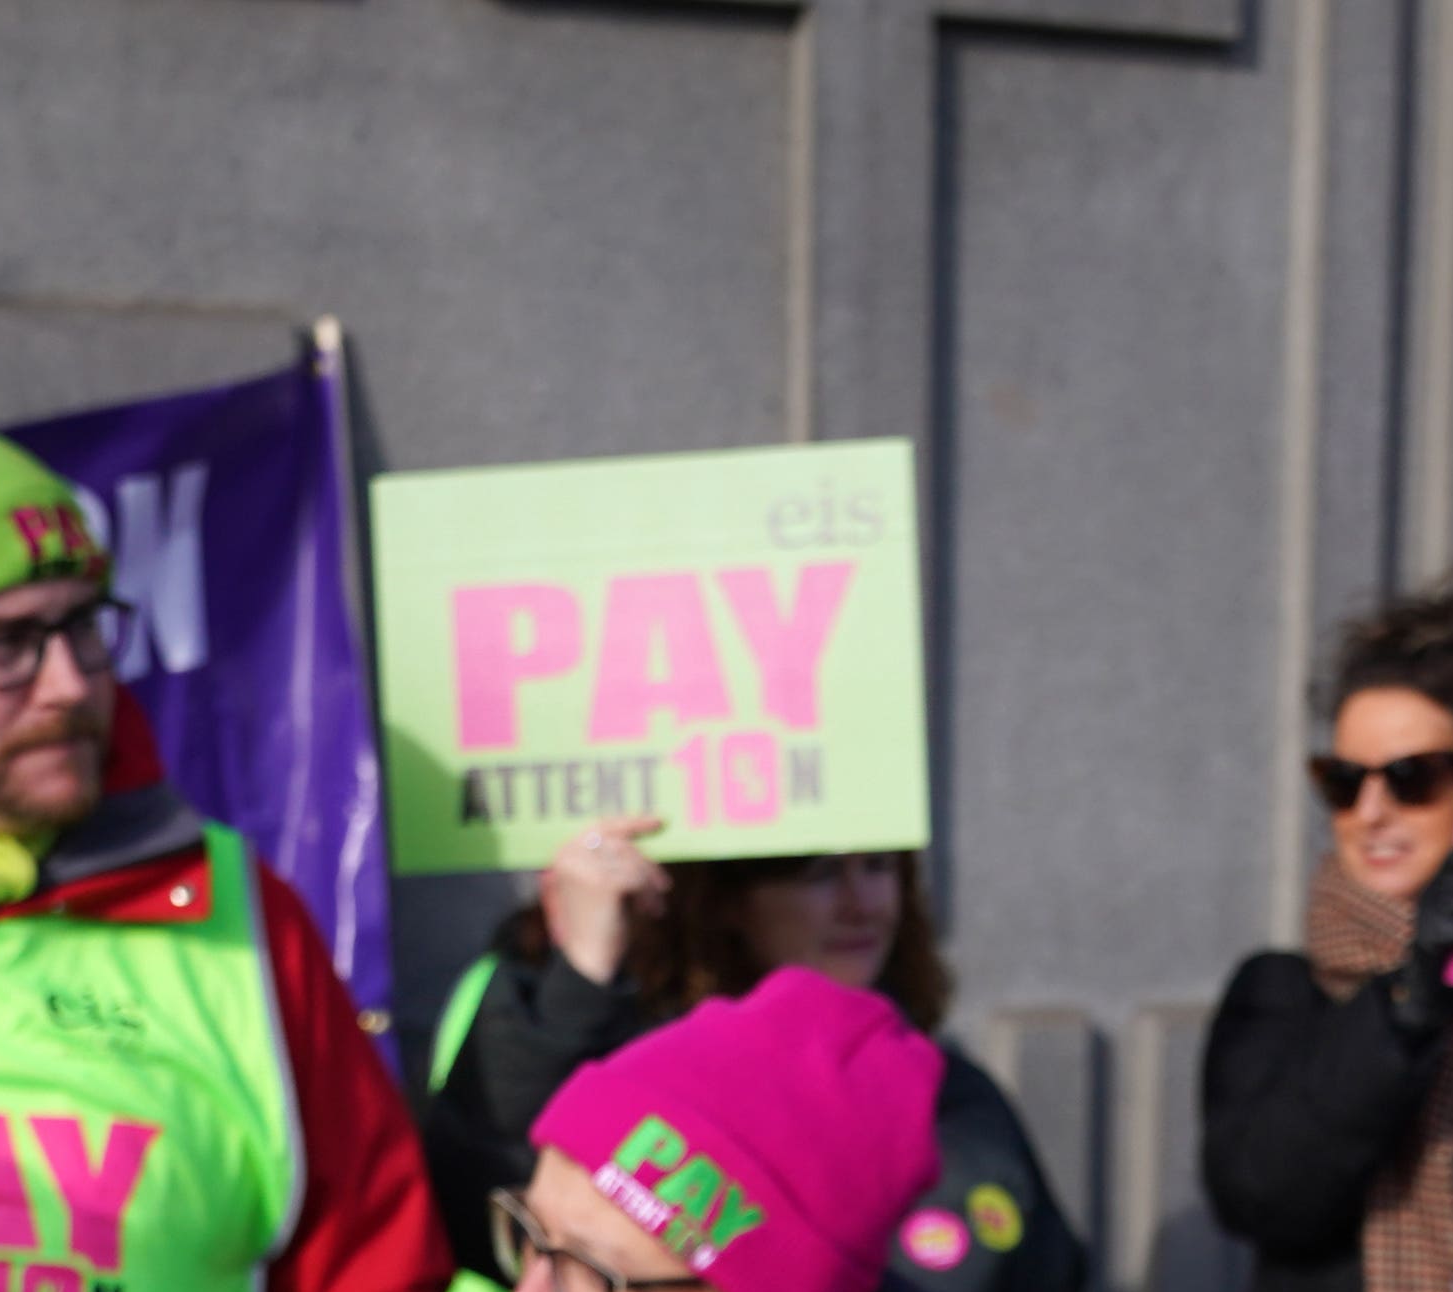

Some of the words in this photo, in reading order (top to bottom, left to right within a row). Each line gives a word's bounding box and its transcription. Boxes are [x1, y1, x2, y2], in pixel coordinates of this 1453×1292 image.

[766, 475, 884, 549] eis
[449, 561, 855, 752] PAY
[613, 1116, 765, 1247] PAY
